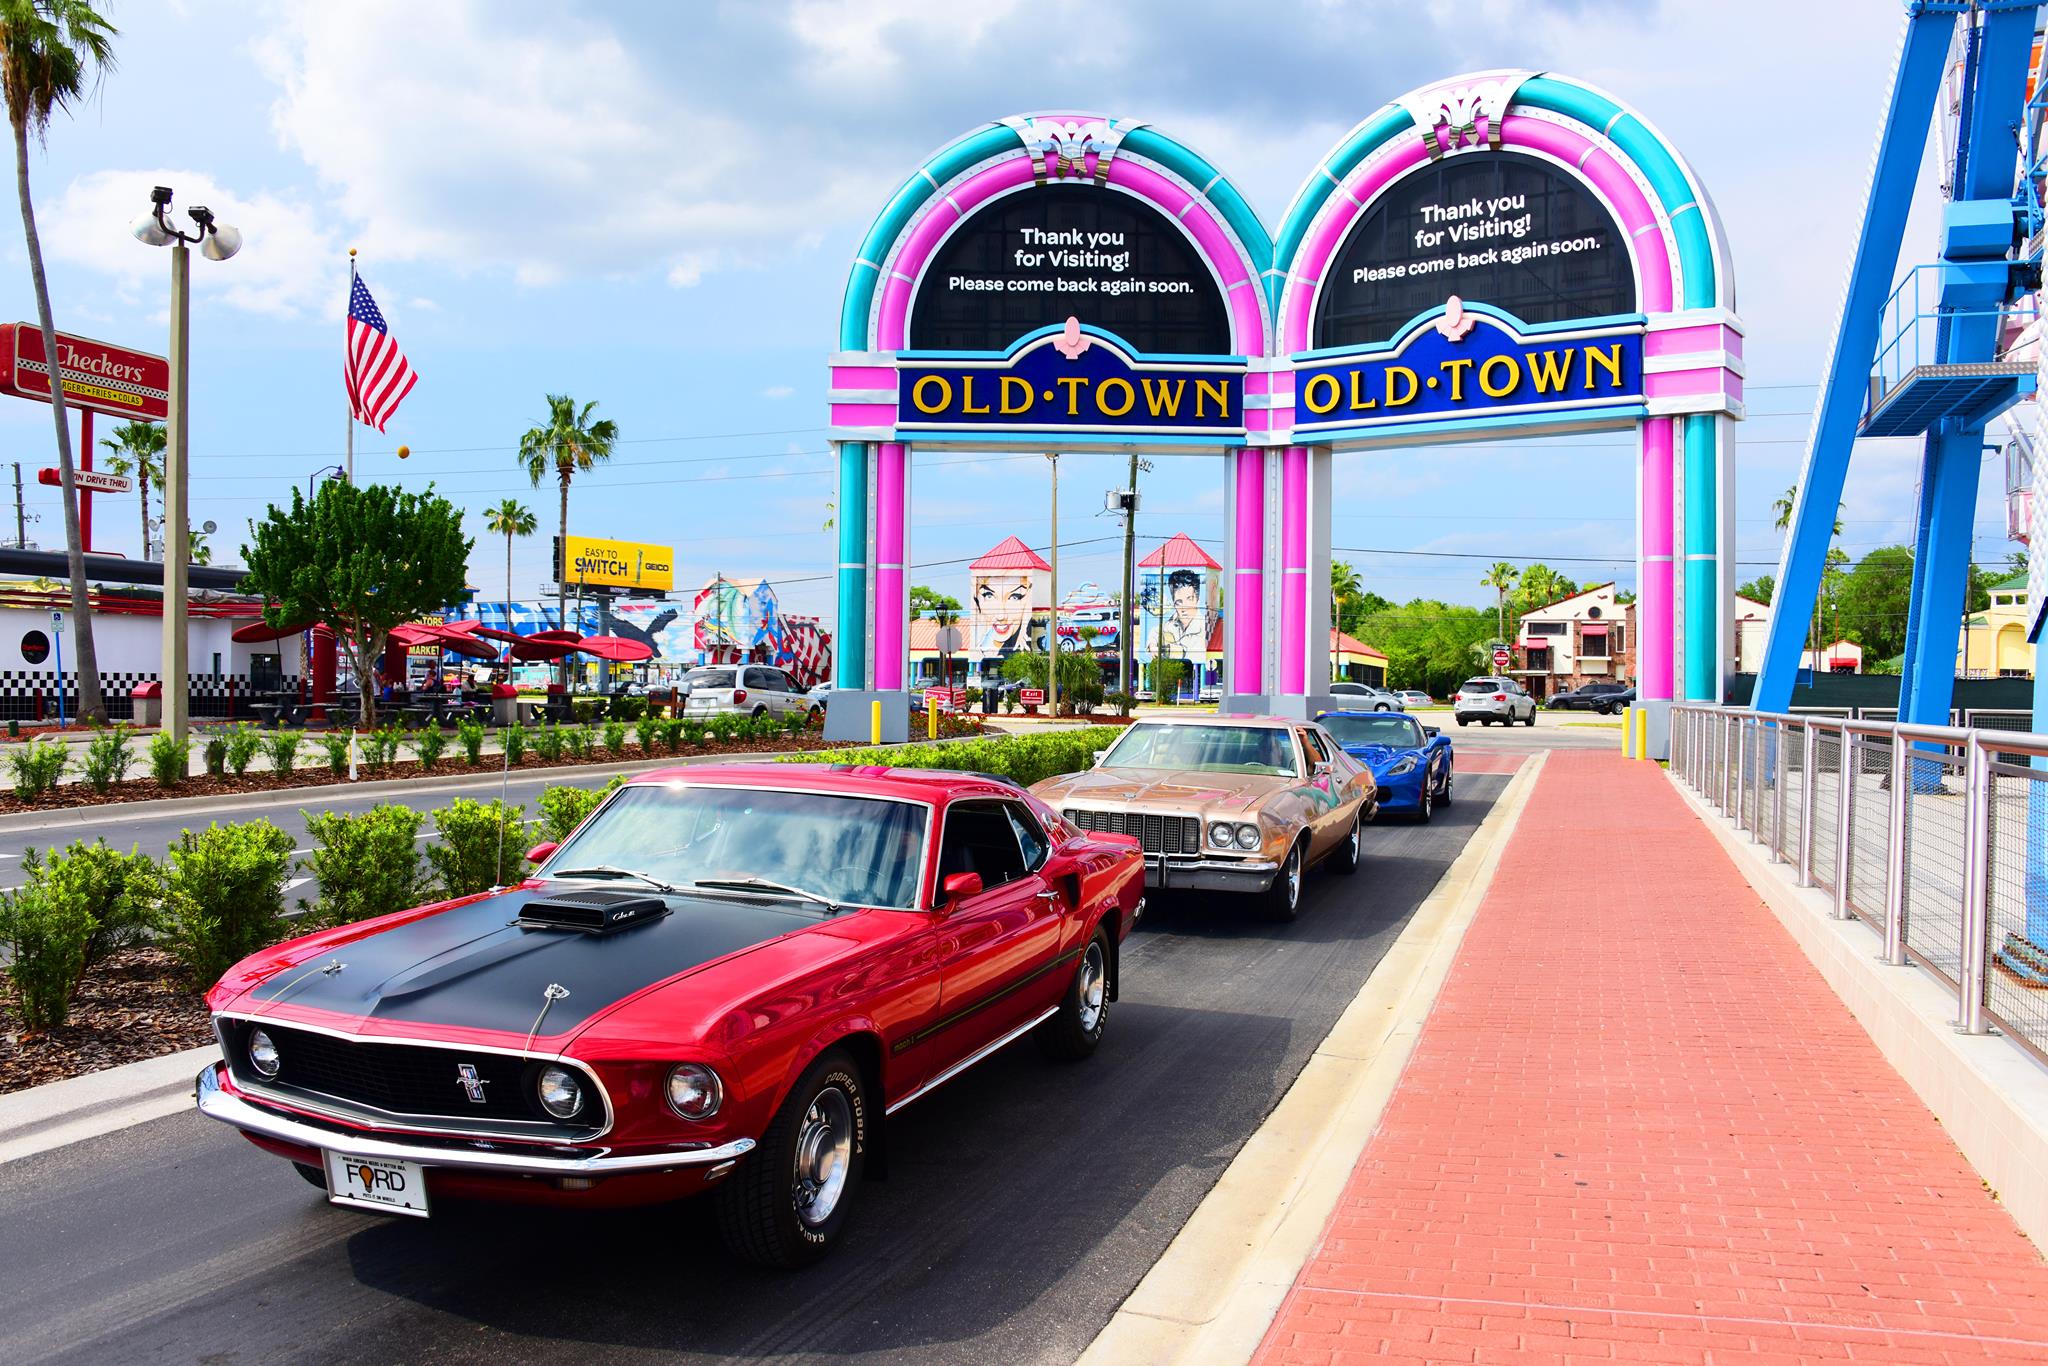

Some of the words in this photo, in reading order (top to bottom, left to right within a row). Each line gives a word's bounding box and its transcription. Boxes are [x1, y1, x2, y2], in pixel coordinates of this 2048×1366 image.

[1421, 198, 1484, 224] Thank
[1486, 194, 1525, 216] you
[1020, 228, 1083, 246] Thank
[1087, 231, 1125, 249] you
[1415, 230, 1445, 248] for
[1449, 213, 1532, 243] Visiting!
[1014, 250, 1045, 267] for
[1049, 250, 1130, 272] Visiting!
[1353, 265, 1405, 284] Please
[1408, 258, 1455, 276] come
[1457, 248, 1498, 269] back
[1500, 241, 1549, 264] again
[1551, 236, 1601, 255] soon.
[949, 276, 1004, 292] Please
[1007, 280, 1054, 293] come
[1057, 277, 1098, 293] back
[1100, 278, 1145, 295] again
[1148, 280, 1194, 294] soon.
[56, 343, 143, 382] Checkers
[62, 382, 86, 393] RGERS
[92, 388, 112, 399] FRIES
[118, 393, 140, 404] COLAS
[86, 475, 107, 485] DRIVE
[110, 478, 127, 489] THRU
[585, 548, 605, 558] EASY
[607, 549, 618, 559] TO
[575, 557, 628, 576] SWITCH
[645, 562, 669, 572] GEICO
[824, 1072, 857, 1094] COOPER
[853, 1096, 864, 1154] COBRA
